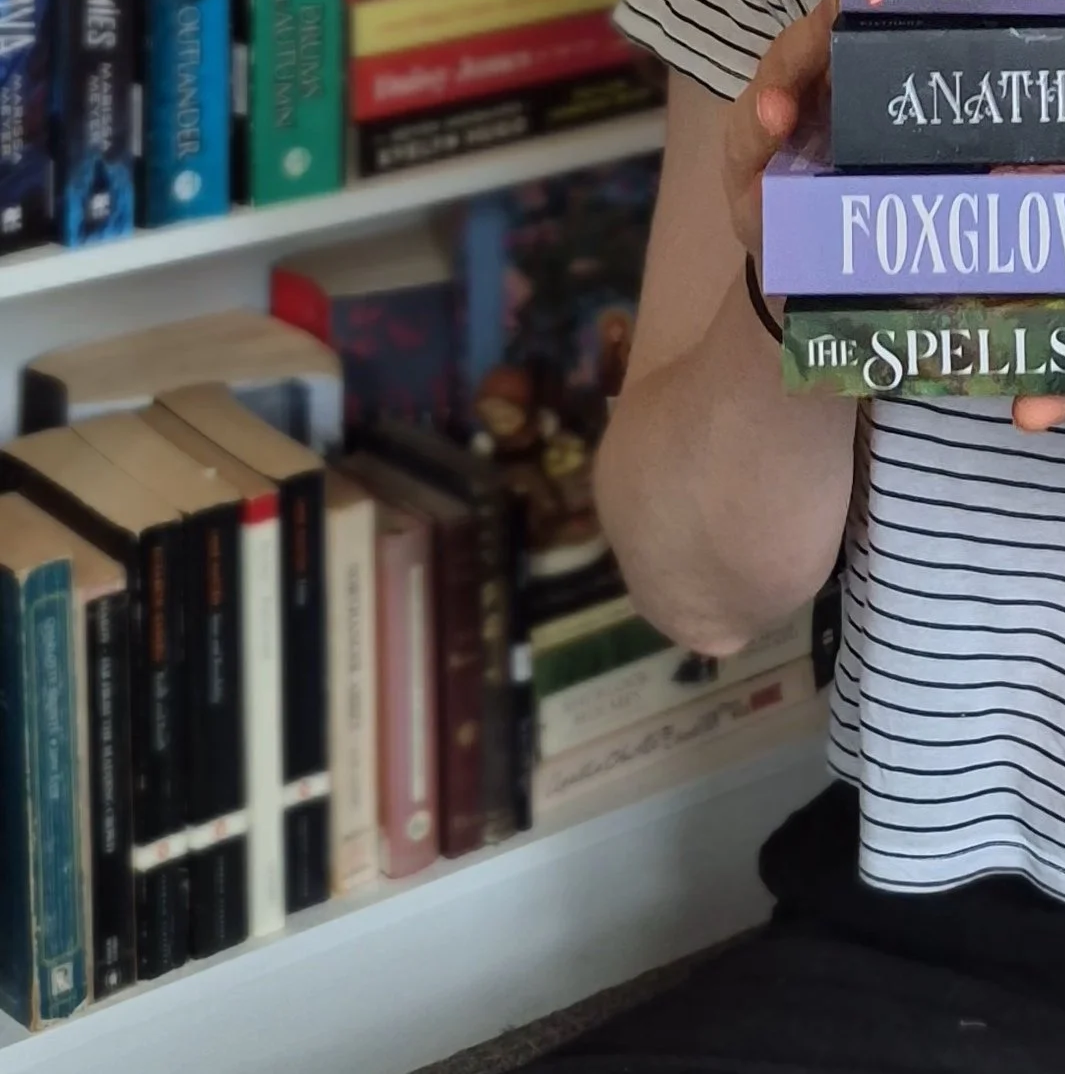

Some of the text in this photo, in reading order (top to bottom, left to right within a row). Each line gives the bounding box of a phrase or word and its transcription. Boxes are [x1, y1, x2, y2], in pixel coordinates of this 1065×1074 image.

[176, 5, 201, 160] OUTLANDER
[272, 6, 297, 130] AUTUMN
[298, 3, 324, 98] DRUMS
[808, 332, 858, 368] THE
